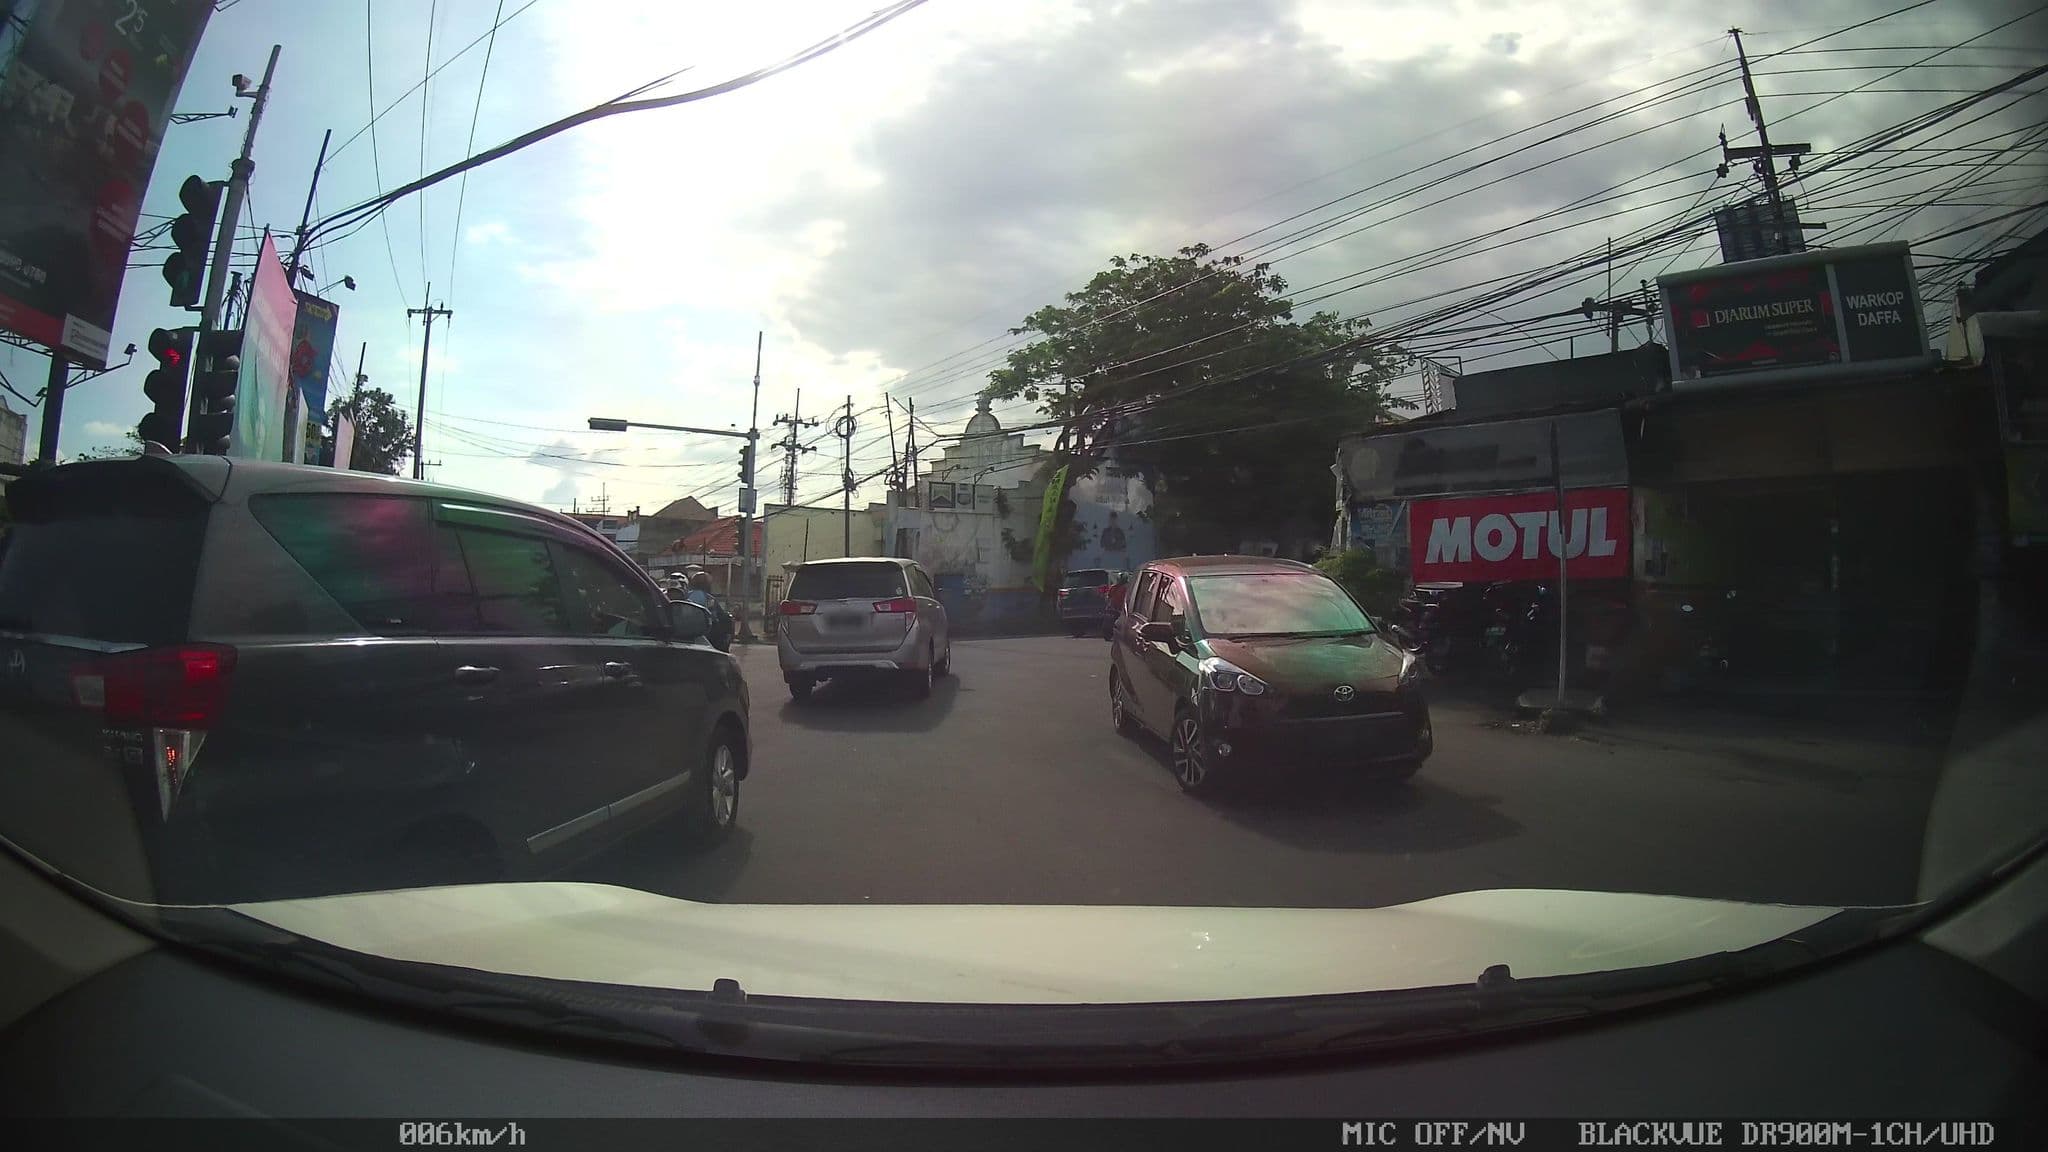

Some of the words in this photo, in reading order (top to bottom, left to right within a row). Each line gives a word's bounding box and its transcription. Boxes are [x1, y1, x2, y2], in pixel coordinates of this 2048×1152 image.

[1714, 304, 1770, 324] DJARUM
[1771, 299, 1814, 317] SUPER
[1845, 291, 1904, 310] WARKOP
[1857, 310, 1902, 327] DAFFA
[1424, 507, 1617, 564] MOTUL
